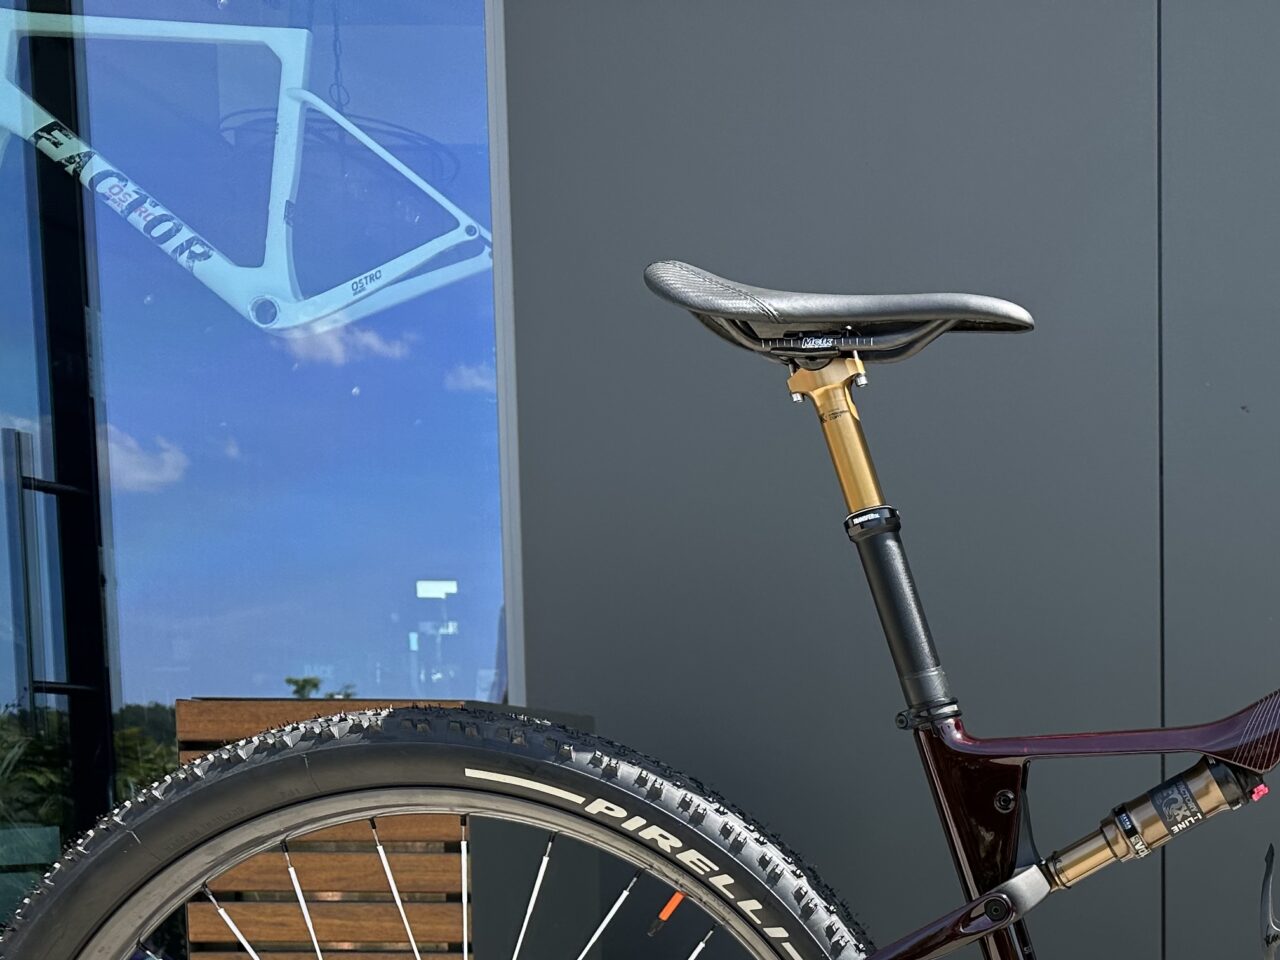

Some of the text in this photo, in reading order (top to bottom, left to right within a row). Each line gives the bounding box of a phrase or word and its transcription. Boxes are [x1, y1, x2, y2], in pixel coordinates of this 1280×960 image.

[351, 269, 382, 292] OSTRO
[1171, 812, 1202, 834] I-LINE
[584, 798, 789, 938] PIRELLI
